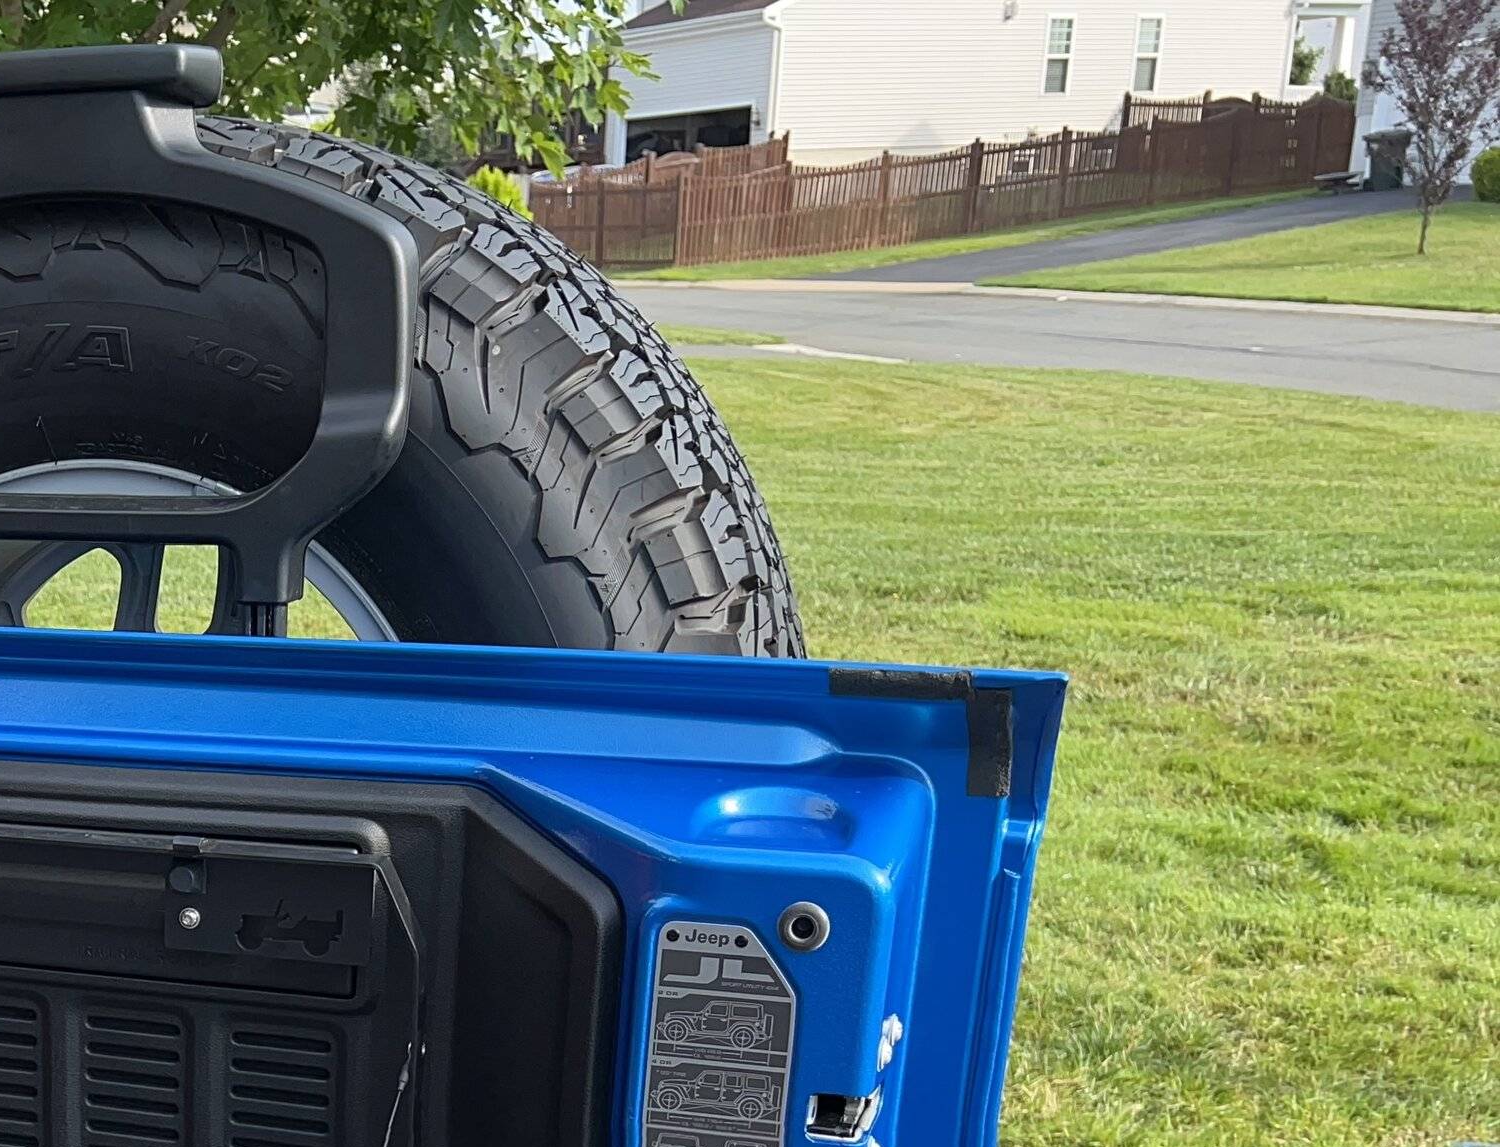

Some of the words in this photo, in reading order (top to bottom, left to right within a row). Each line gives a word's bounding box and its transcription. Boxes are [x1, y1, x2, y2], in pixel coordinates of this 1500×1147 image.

[177, 335, 294, 392] KO2
[685, 929, 730, 947] Jeep
[663, 956, 775, 984] JL
